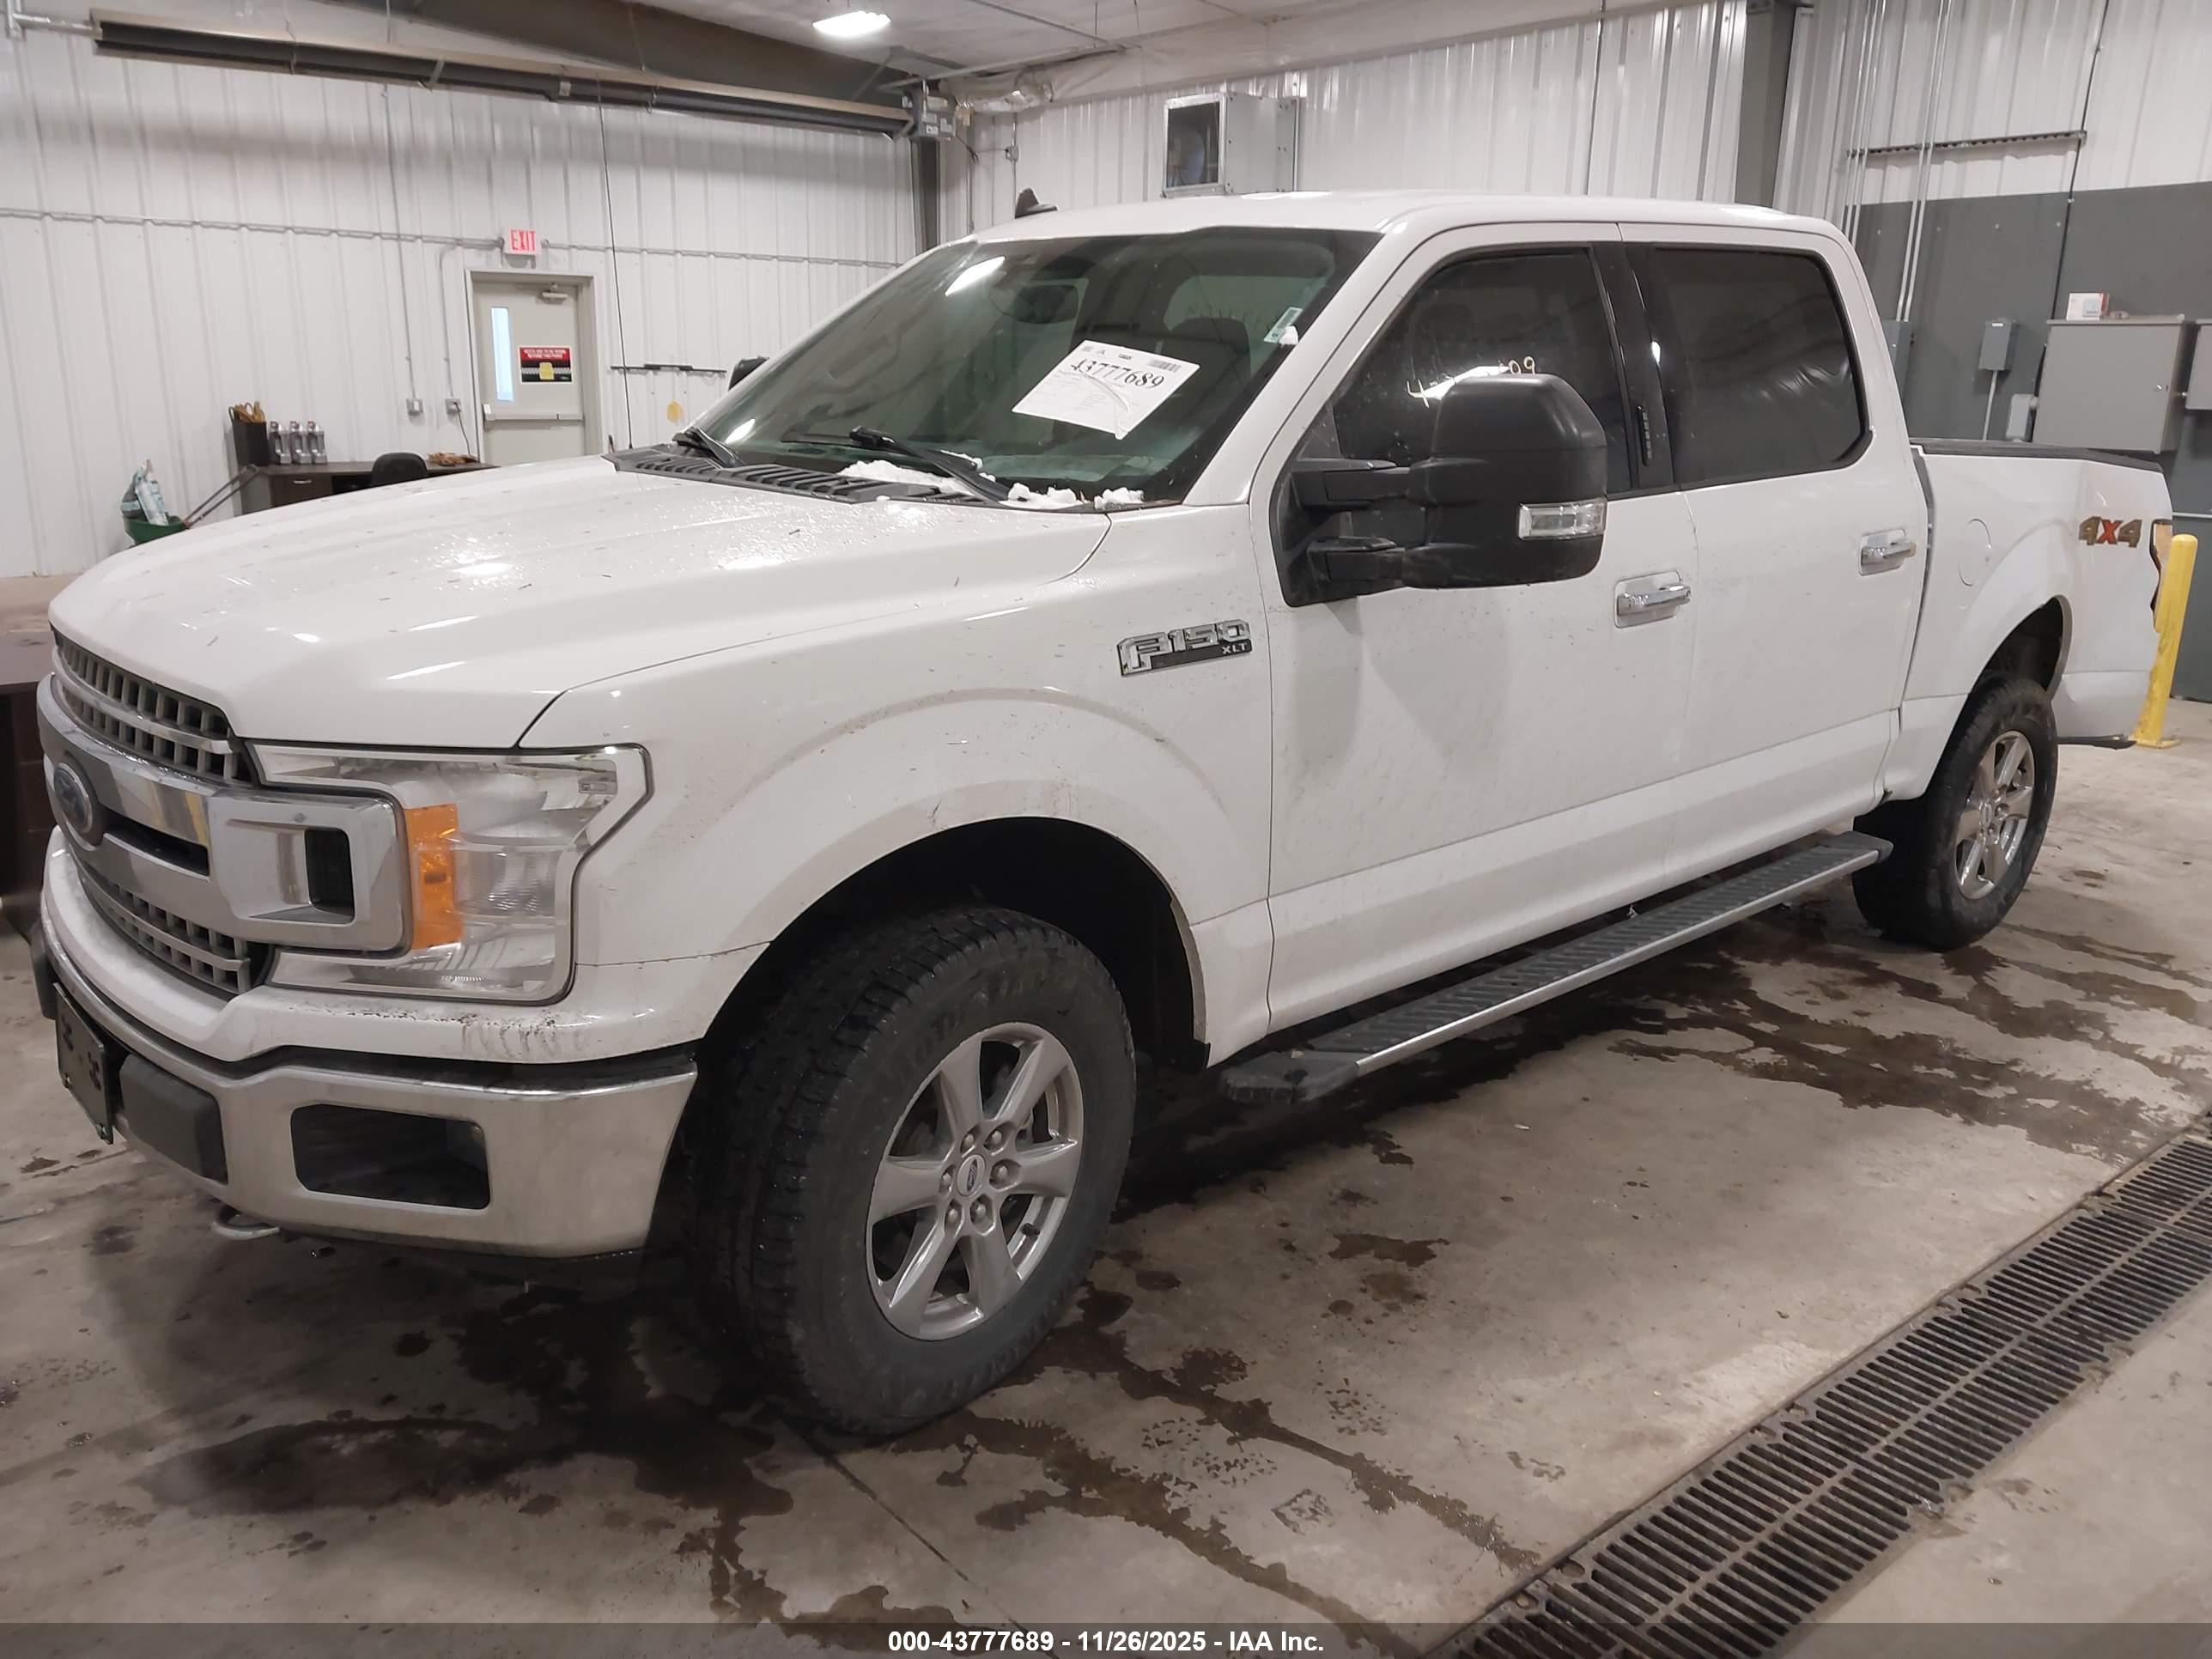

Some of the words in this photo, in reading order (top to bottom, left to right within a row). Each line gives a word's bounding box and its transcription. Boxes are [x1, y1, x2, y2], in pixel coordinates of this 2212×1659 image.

[510, 229, 536, 252] EXIT
[1070, 358, 1164, 388] 43777689
[1222, 642, 1246, 654] XLT
